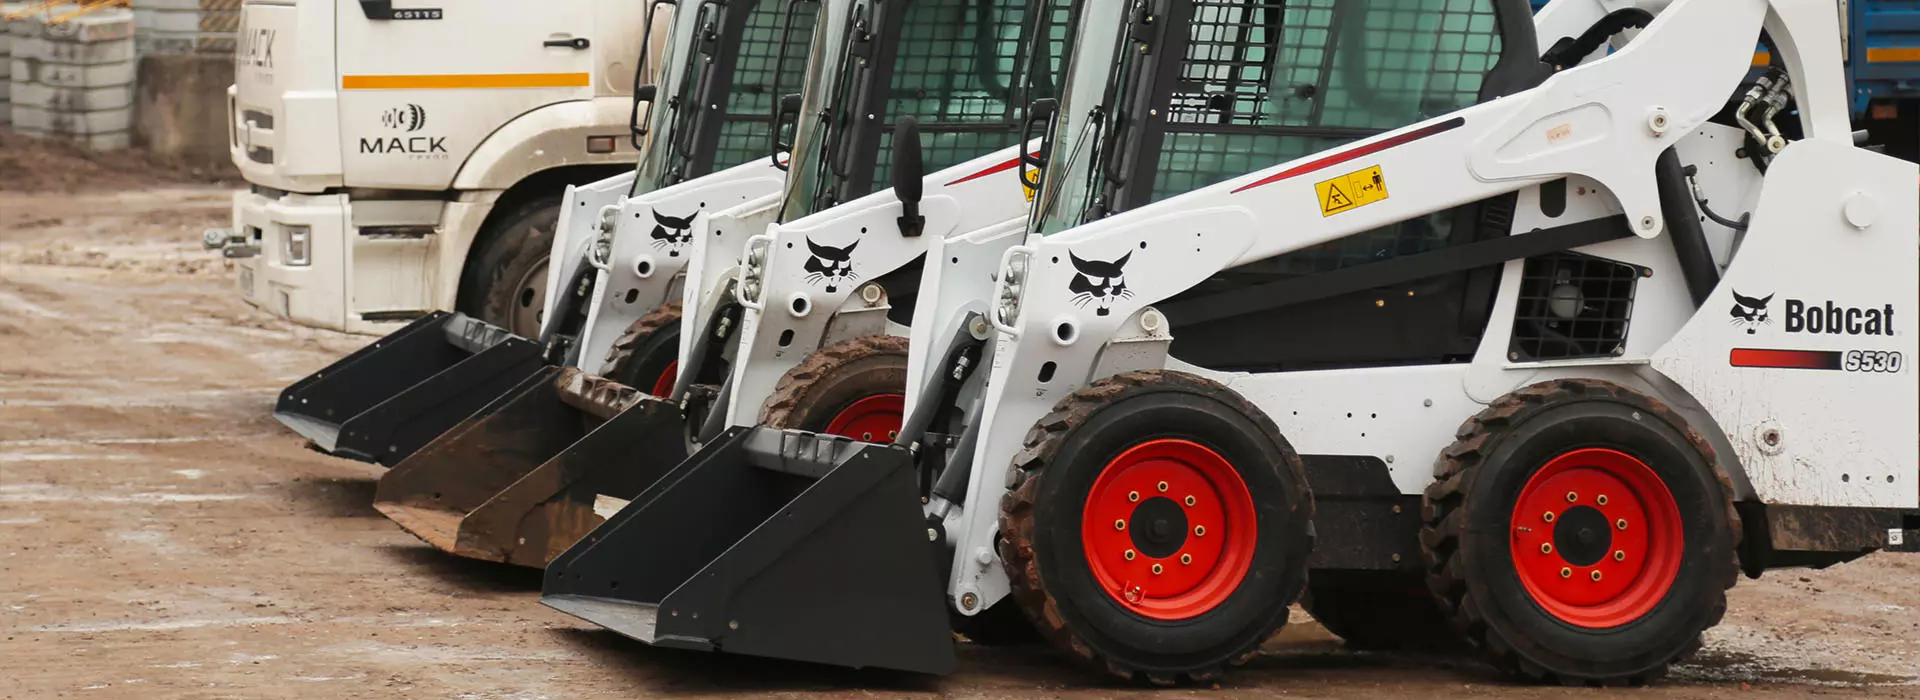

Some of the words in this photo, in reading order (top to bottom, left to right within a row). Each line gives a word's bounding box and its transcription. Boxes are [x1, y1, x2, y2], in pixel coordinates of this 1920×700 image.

[394, 11, 440, 19] 65115
[360, 136, 447, 153] MACK
[1785, 299, 1894, 336] Bobcat
[1846, 350, 1902, 373] S530
